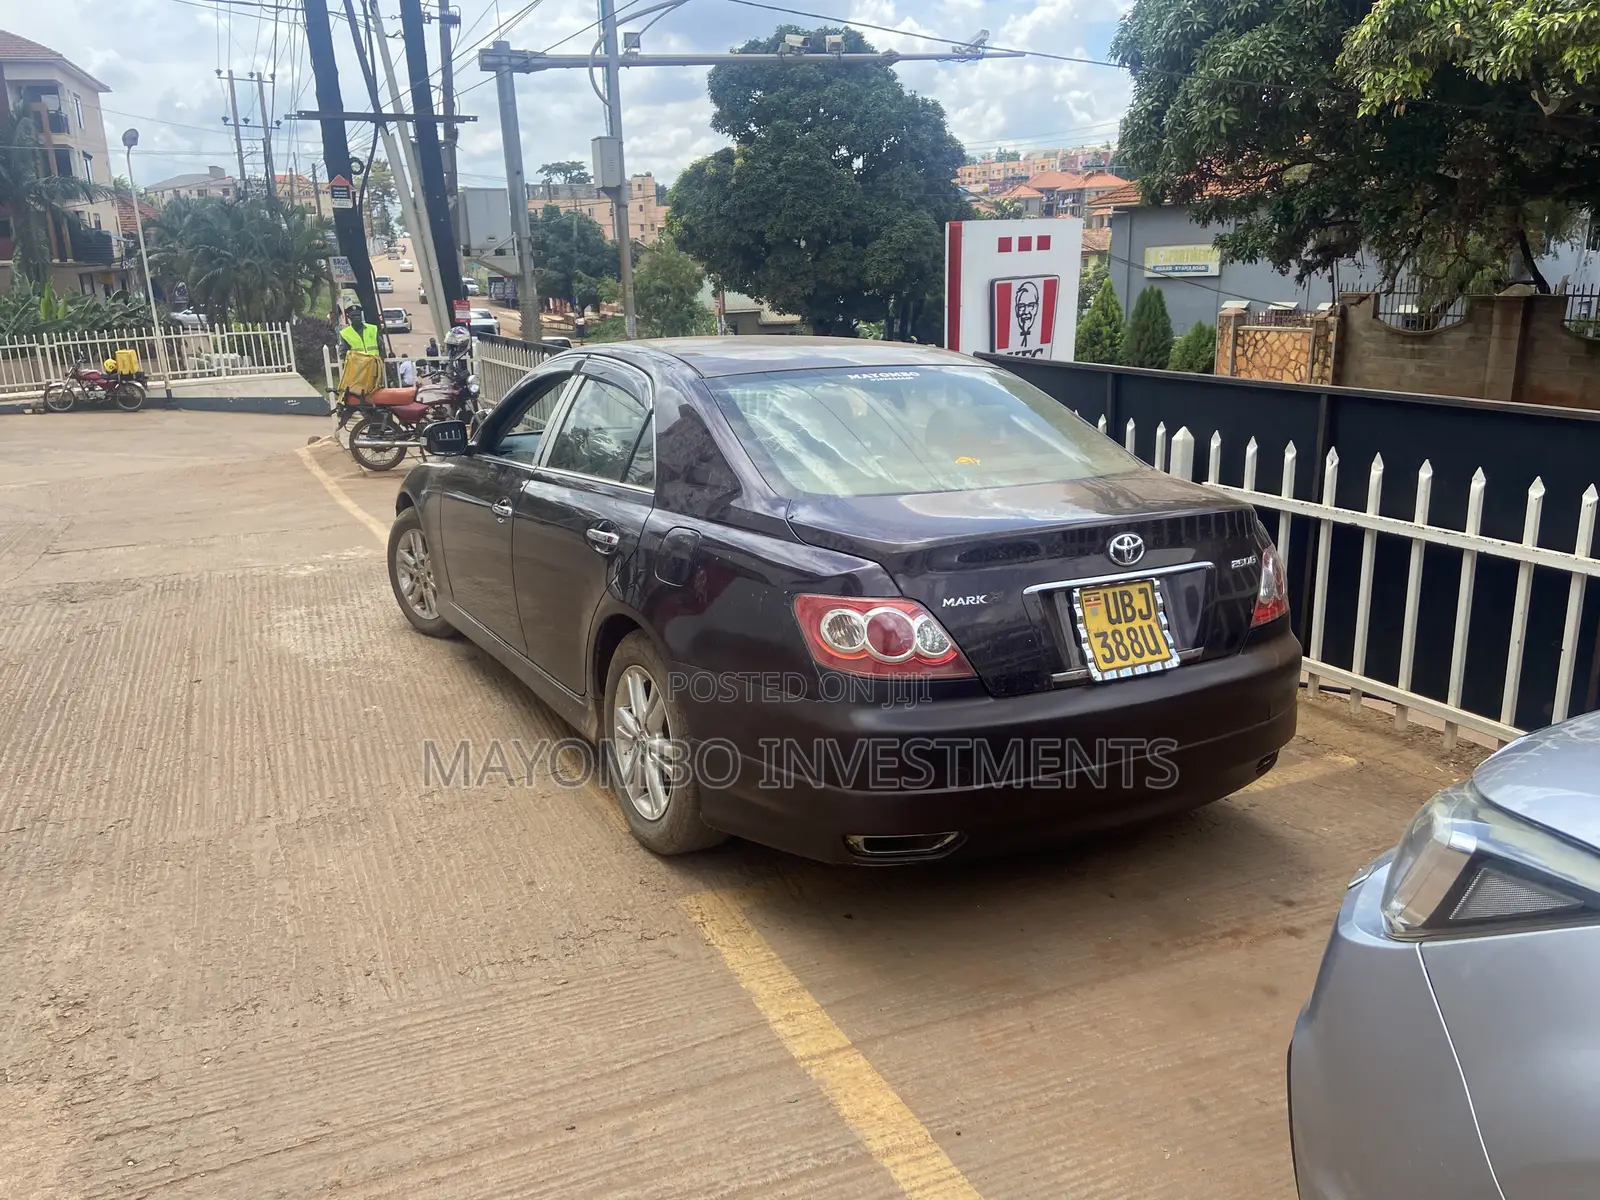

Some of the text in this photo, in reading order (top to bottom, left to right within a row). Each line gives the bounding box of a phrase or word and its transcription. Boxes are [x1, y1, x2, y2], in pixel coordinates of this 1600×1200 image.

[847, 371, 921, 380] MAYOMBO
[941, 594, 988, 608] MARK
[1103, 587, 1153, 626] UBJ
[1093, 624, 1163, 664] 388U
